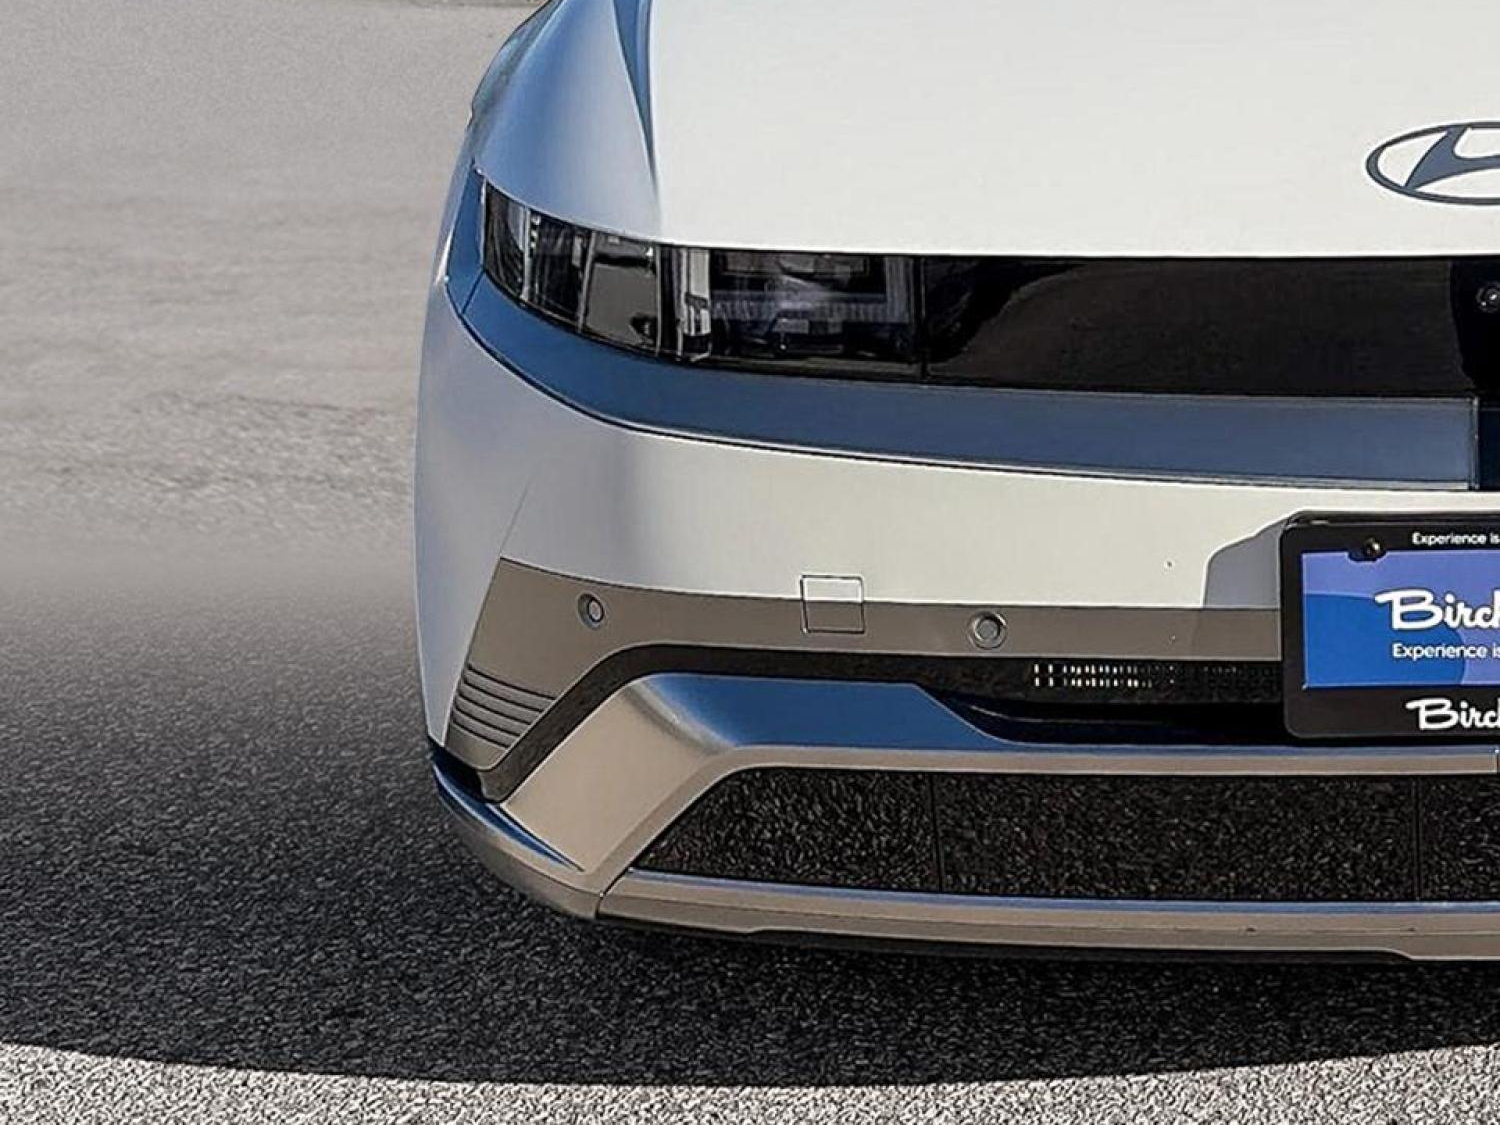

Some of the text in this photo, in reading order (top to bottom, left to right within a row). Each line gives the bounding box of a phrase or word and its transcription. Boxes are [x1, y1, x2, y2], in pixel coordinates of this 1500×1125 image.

[1412, 532, 1487, 545] Experience
[1490, 532, 1500, 544] is
[1392, 643, 1487, 661] Experience
